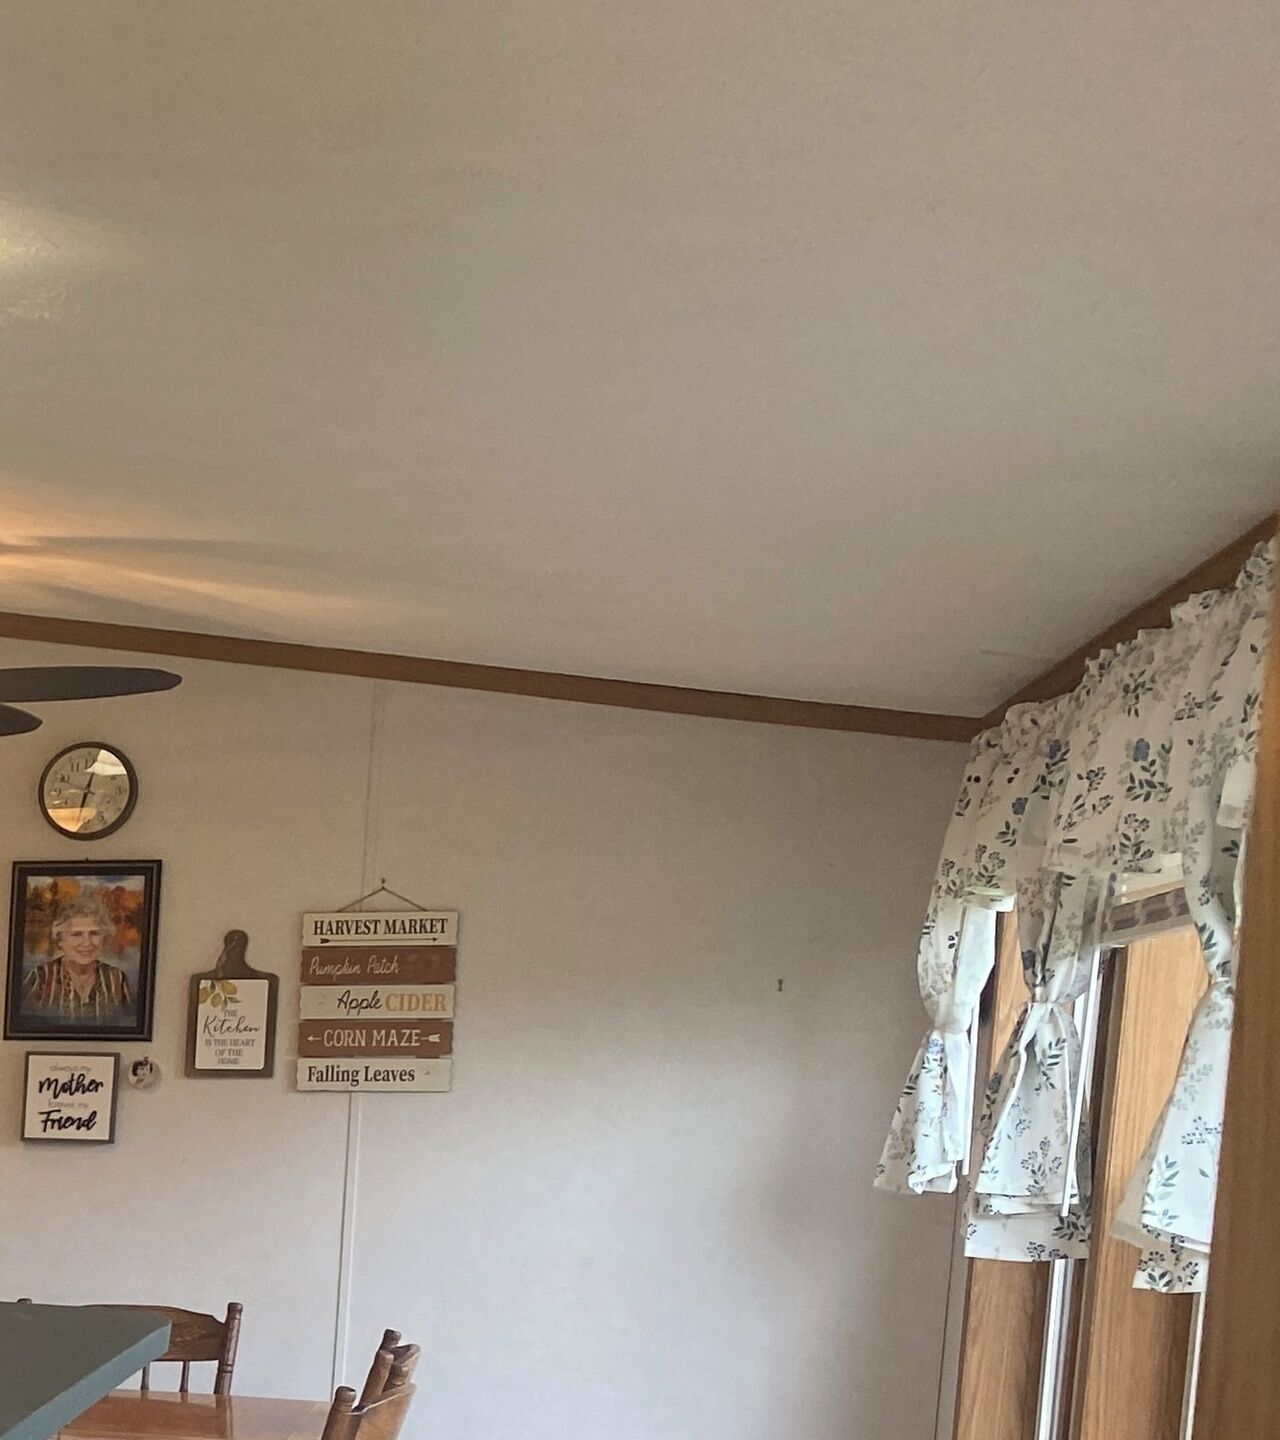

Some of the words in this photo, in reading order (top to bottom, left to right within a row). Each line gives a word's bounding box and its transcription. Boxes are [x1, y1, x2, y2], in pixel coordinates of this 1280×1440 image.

[313, 919, 381, 936] HARVEST
[384, 918, 448, 935] MARKET
[309, 956, 361, 981] Pumpkin
[367, 954, 400, 975] Patch
[336, 989, 383, 1016] Apple
[385, 993, 447, 1012] CIDER
[202, 1014, 260, 1038] Kitchen
[323, 1029, 366, 1047] CORN
[372, 1029, 421, 1047] MAZE
[307, 1065, 360, 1087] Falling
[363, 1065, 415, 1082] Leaves
[38, 1109, 98, 1133] Friend
